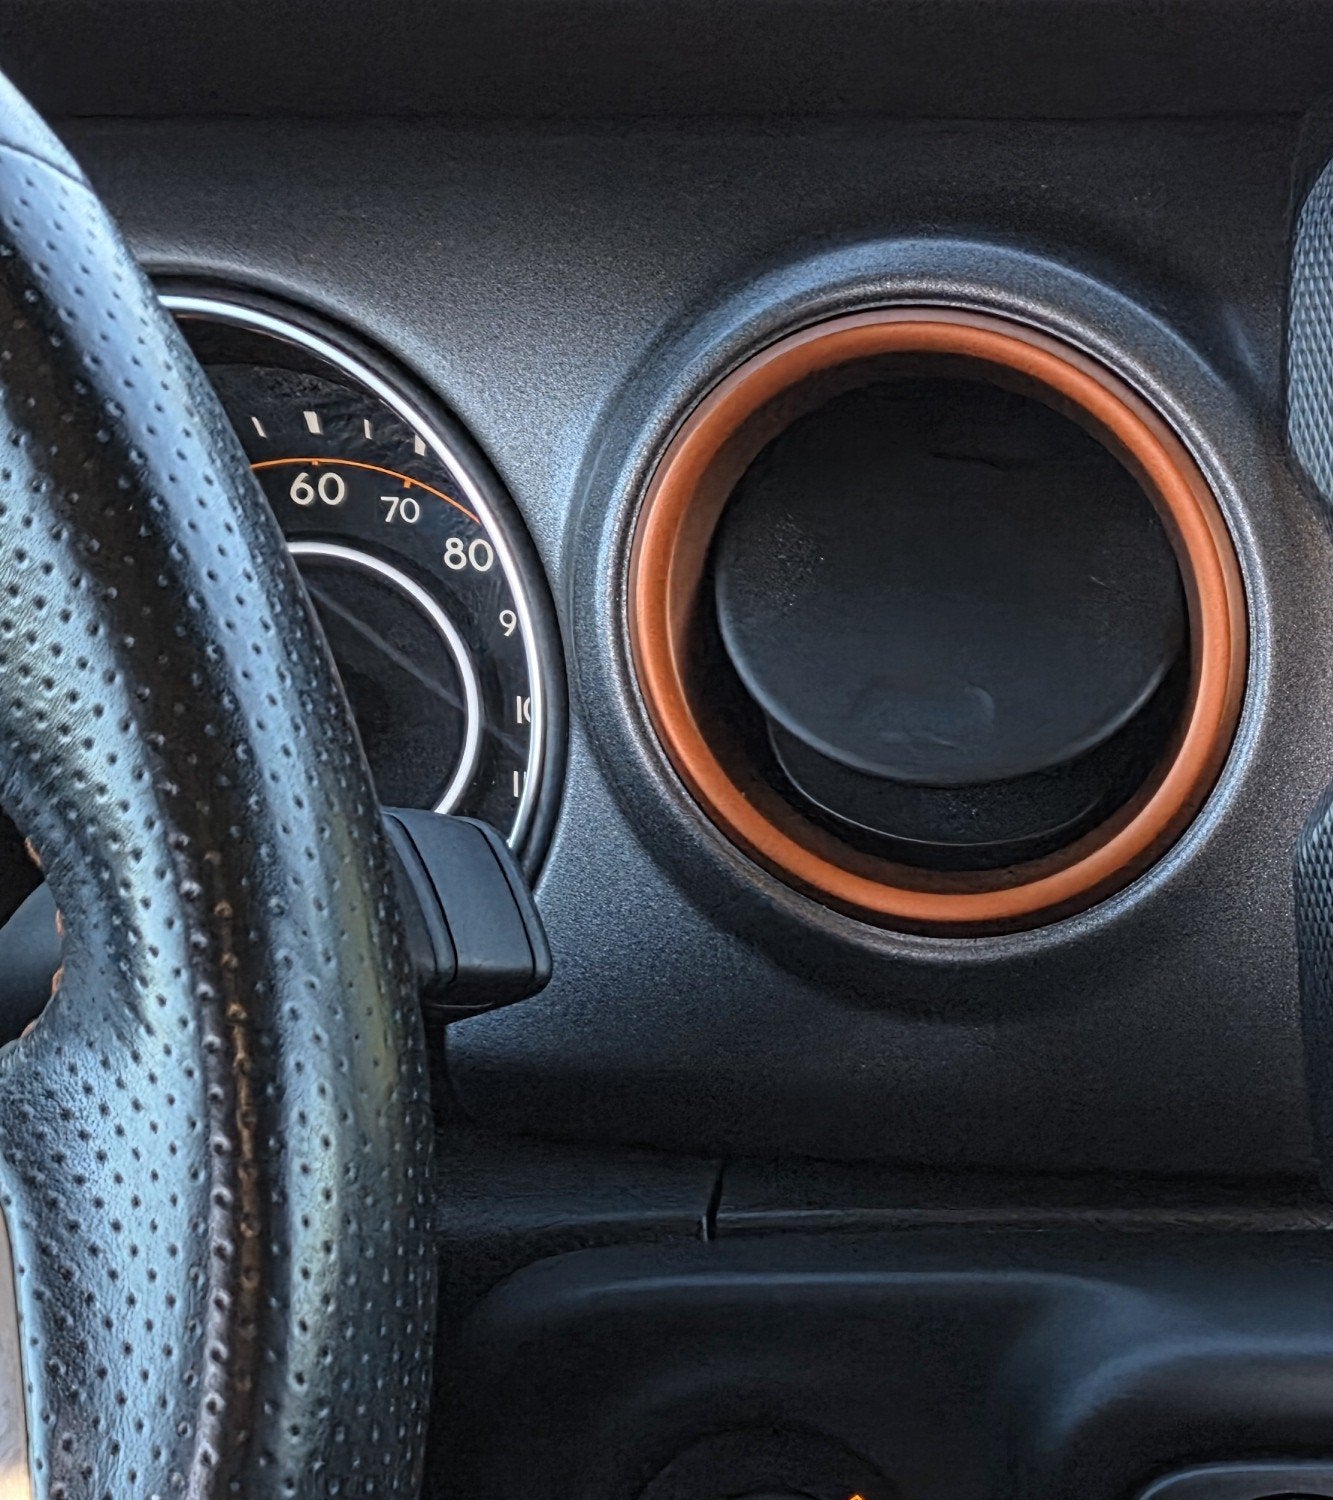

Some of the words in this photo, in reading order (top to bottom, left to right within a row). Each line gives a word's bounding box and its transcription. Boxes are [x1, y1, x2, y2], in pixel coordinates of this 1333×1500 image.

[289, 472, 346, 506] 60
[380, 496, 421, 524] 70
[443, 537, 494, 572] 80
